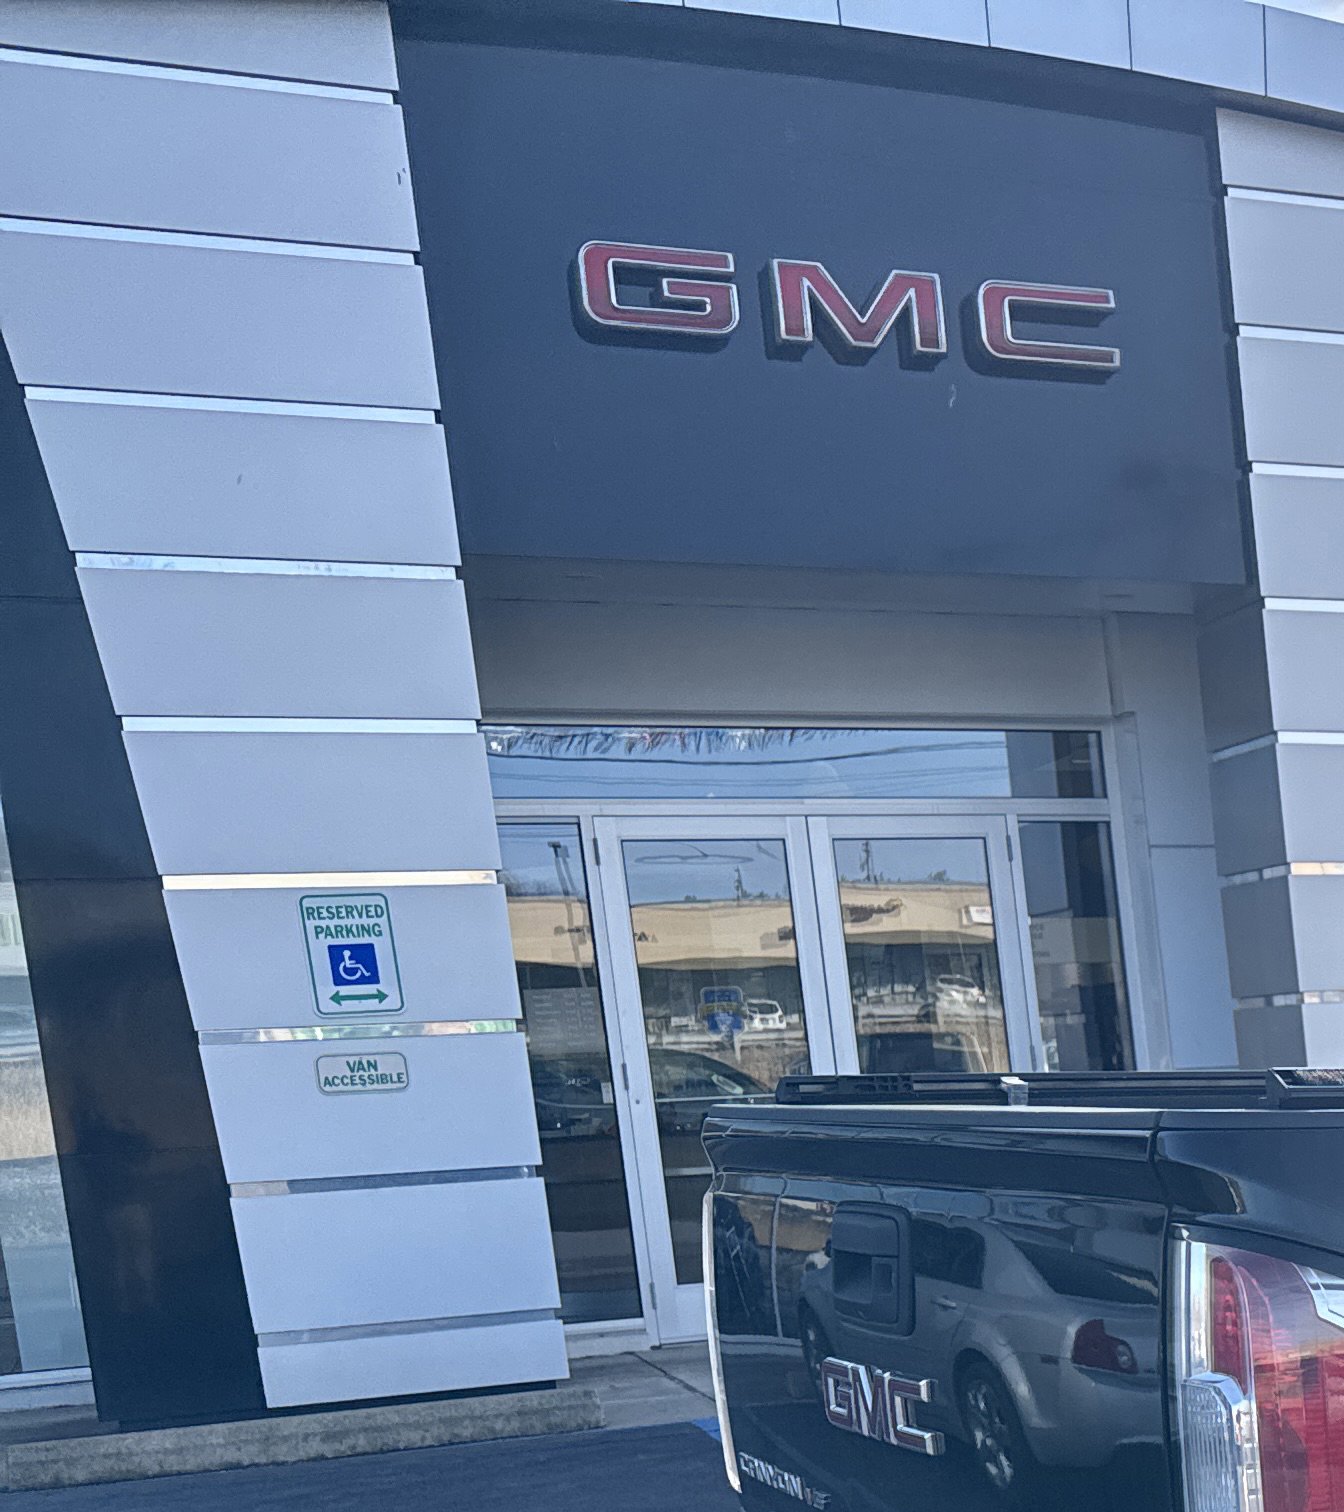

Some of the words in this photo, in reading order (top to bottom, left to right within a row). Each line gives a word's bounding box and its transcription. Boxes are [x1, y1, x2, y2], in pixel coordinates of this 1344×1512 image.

[577, 238, 1121, 368] GMC
[305, 904, 385, 921] RESERVED
[314, 923, 383, 940] PARKING
[346, 1059, 379, 1074] VAN
[323, 1072, 405, 1089] ACCESSIBLE
[822, 1356, 945, 1456] GMC
[739, 1451, 804, 1500] CANYON
